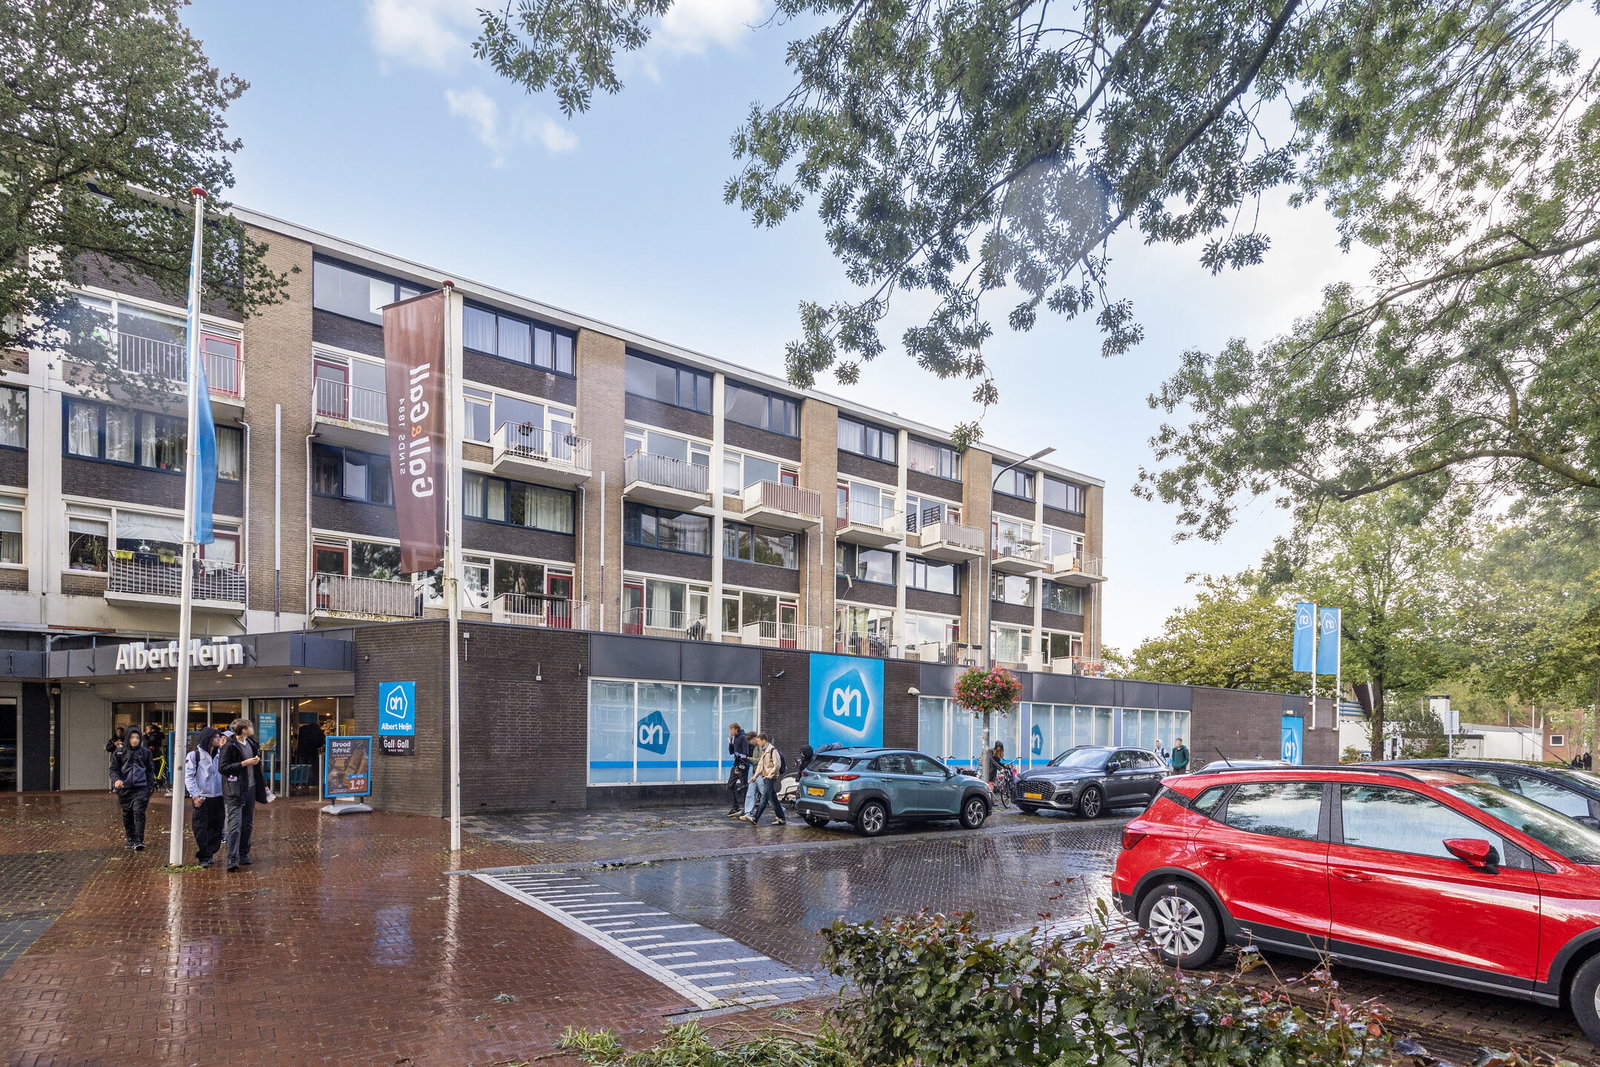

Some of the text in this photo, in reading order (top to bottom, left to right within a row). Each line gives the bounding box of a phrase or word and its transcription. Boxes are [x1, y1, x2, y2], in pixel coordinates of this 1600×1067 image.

[115, 636, 244, 673] Albert Heijn
[381, 722, 413, 731] Albert Heijn
